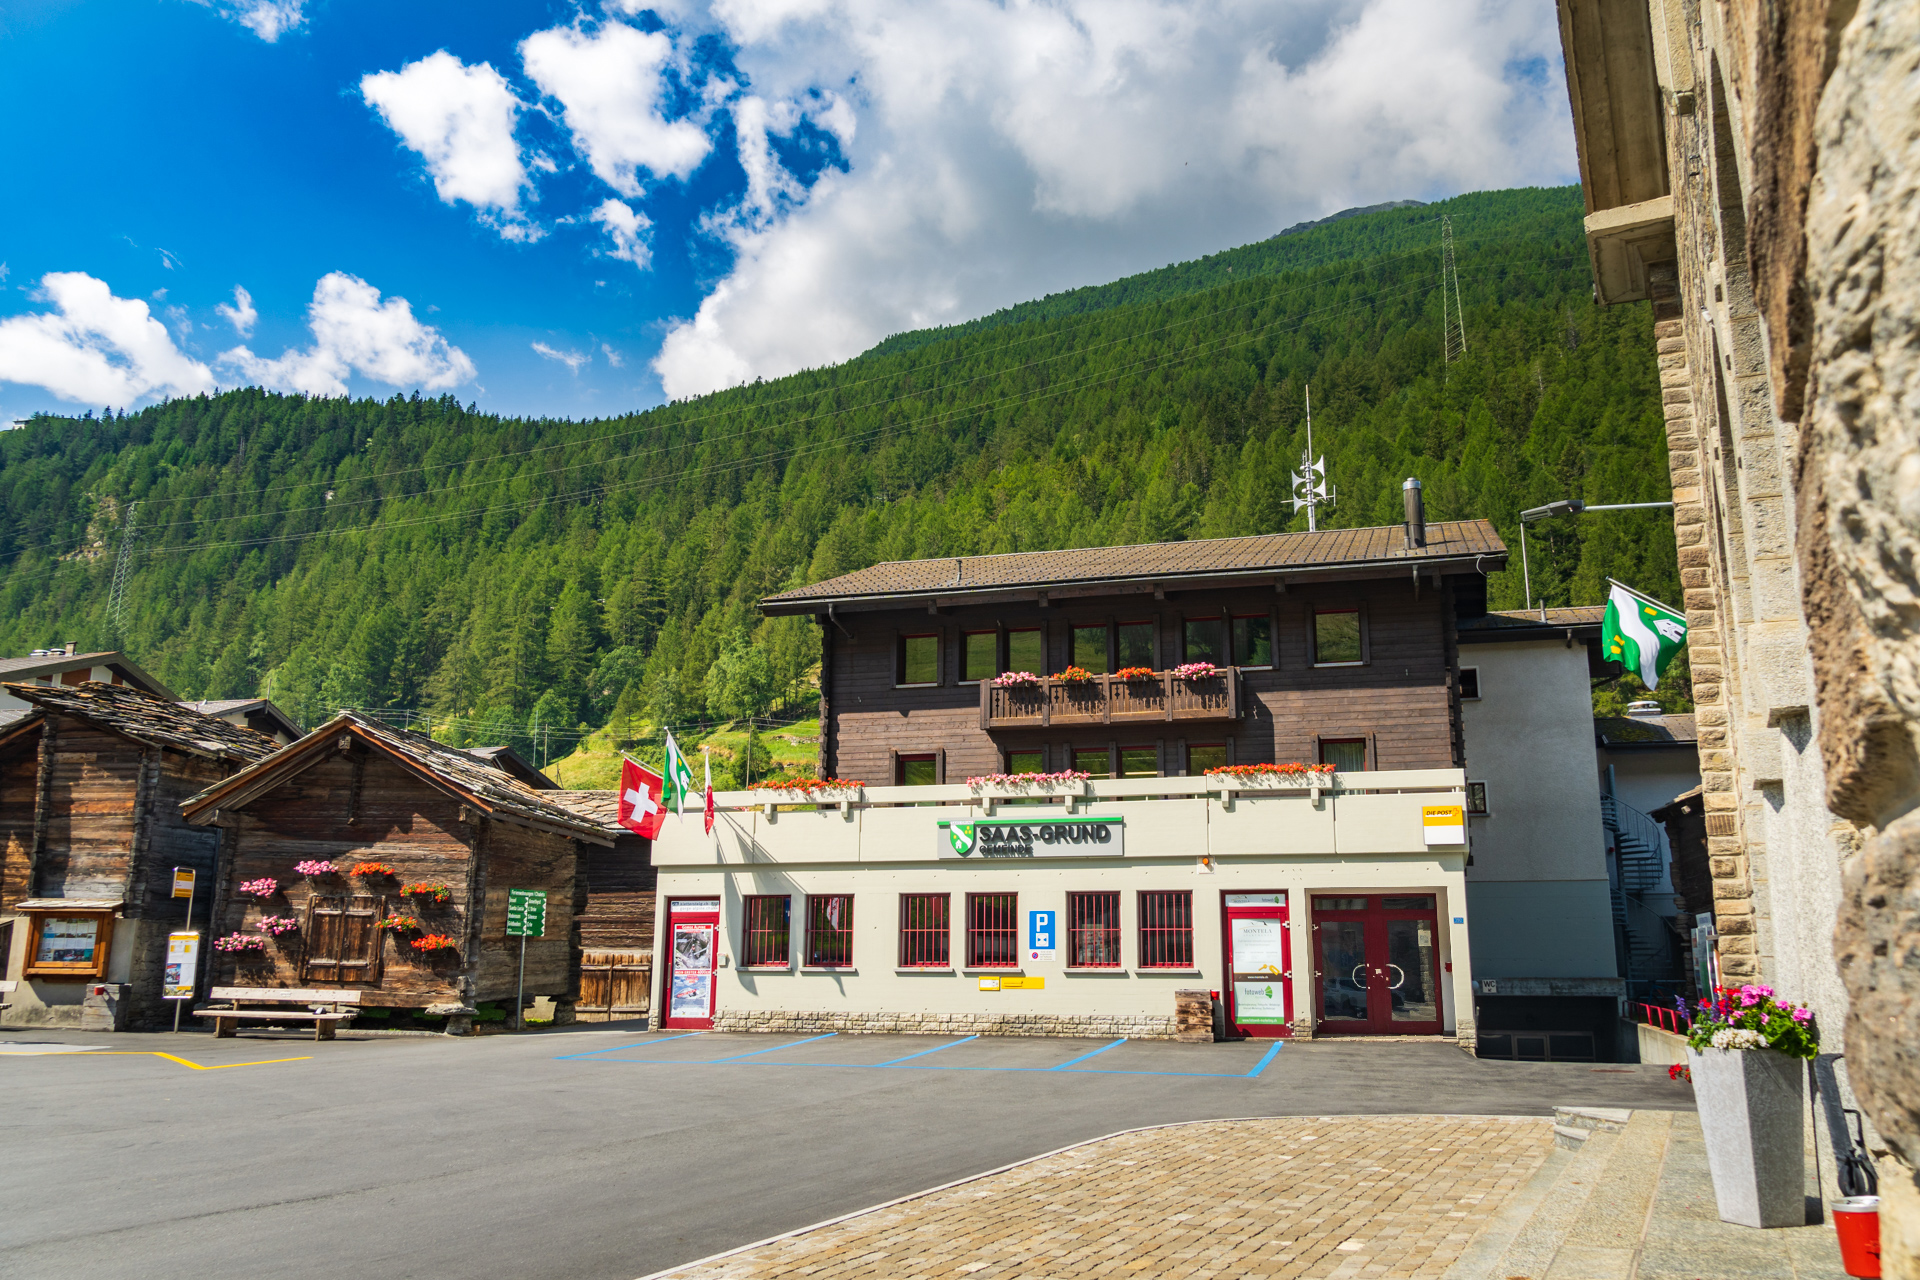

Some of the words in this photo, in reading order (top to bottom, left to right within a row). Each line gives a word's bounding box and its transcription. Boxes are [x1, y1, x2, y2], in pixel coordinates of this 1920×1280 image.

[979, 824, 1110, 844] SAAS-GRUND
[979, 844, 1032, 854] GEMEINDE
[1036, 913, 1048, 932] P
